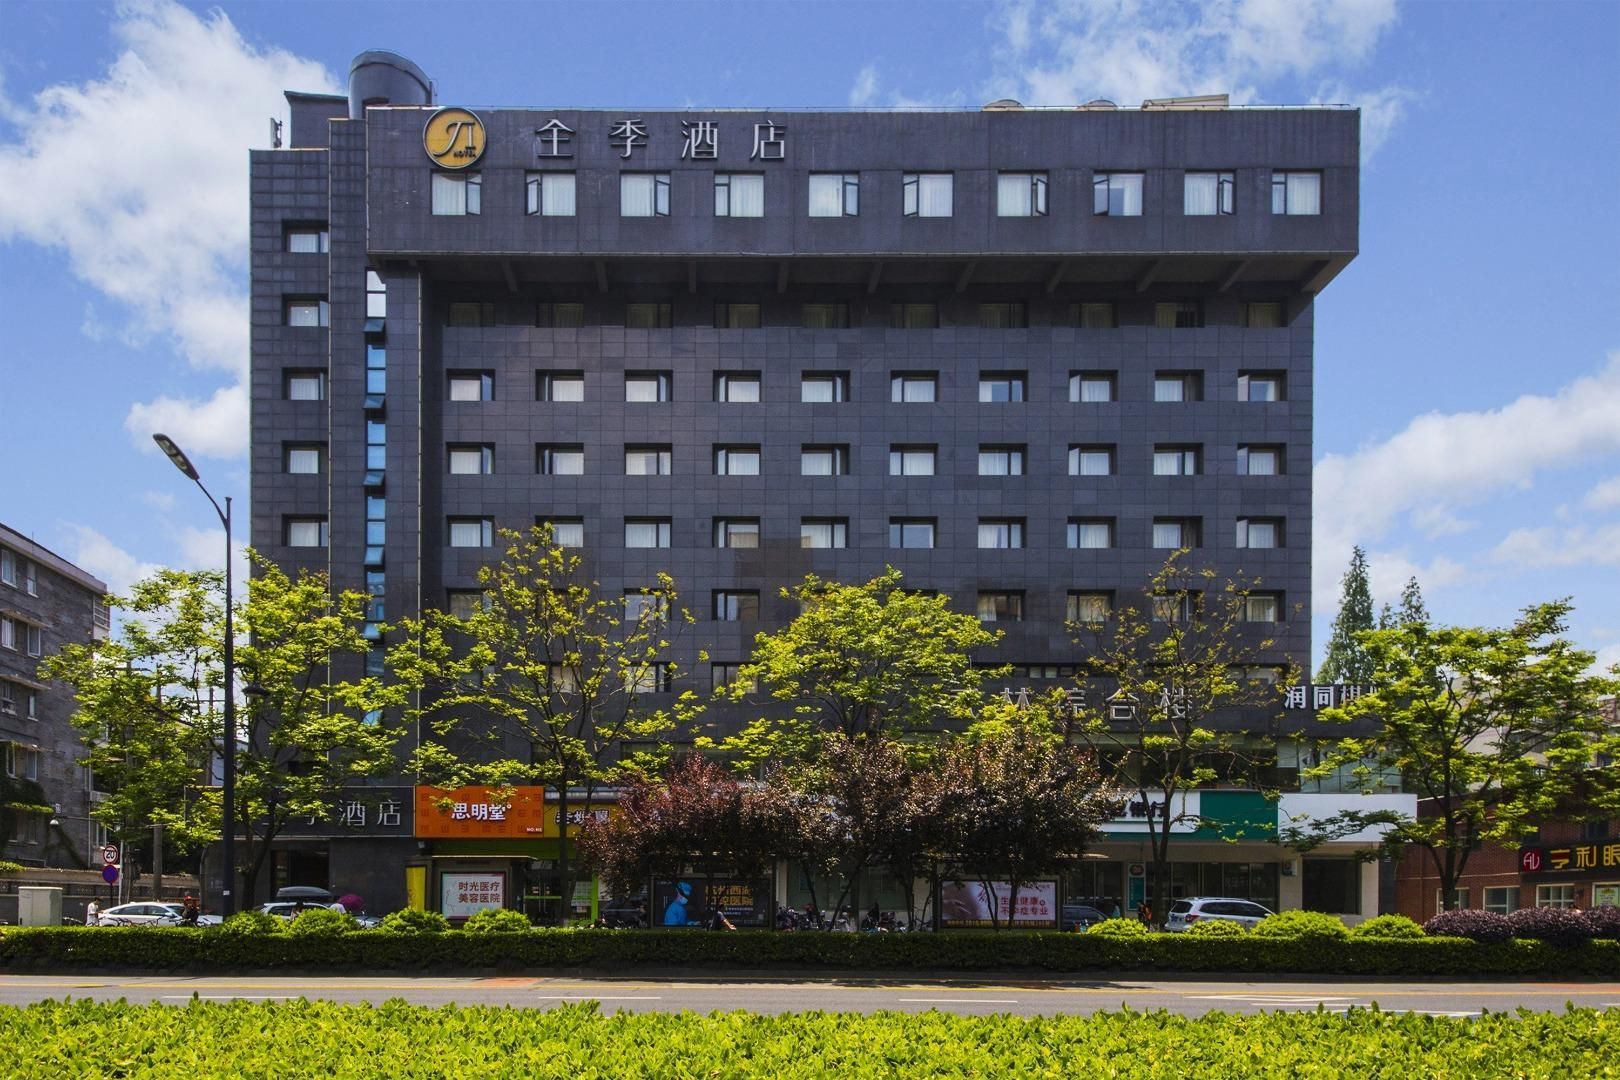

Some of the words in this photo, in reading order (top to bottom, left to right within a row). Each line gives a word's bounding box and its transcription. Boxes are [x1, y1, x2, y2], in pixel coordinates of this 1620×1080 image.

[536, 118, 785, 160] 全季酒店
[451, 802, 506, 820] 思明堂
[458, 881, 500, 892] 时光医疗
[458, 893, 501, 904] 美容医院
